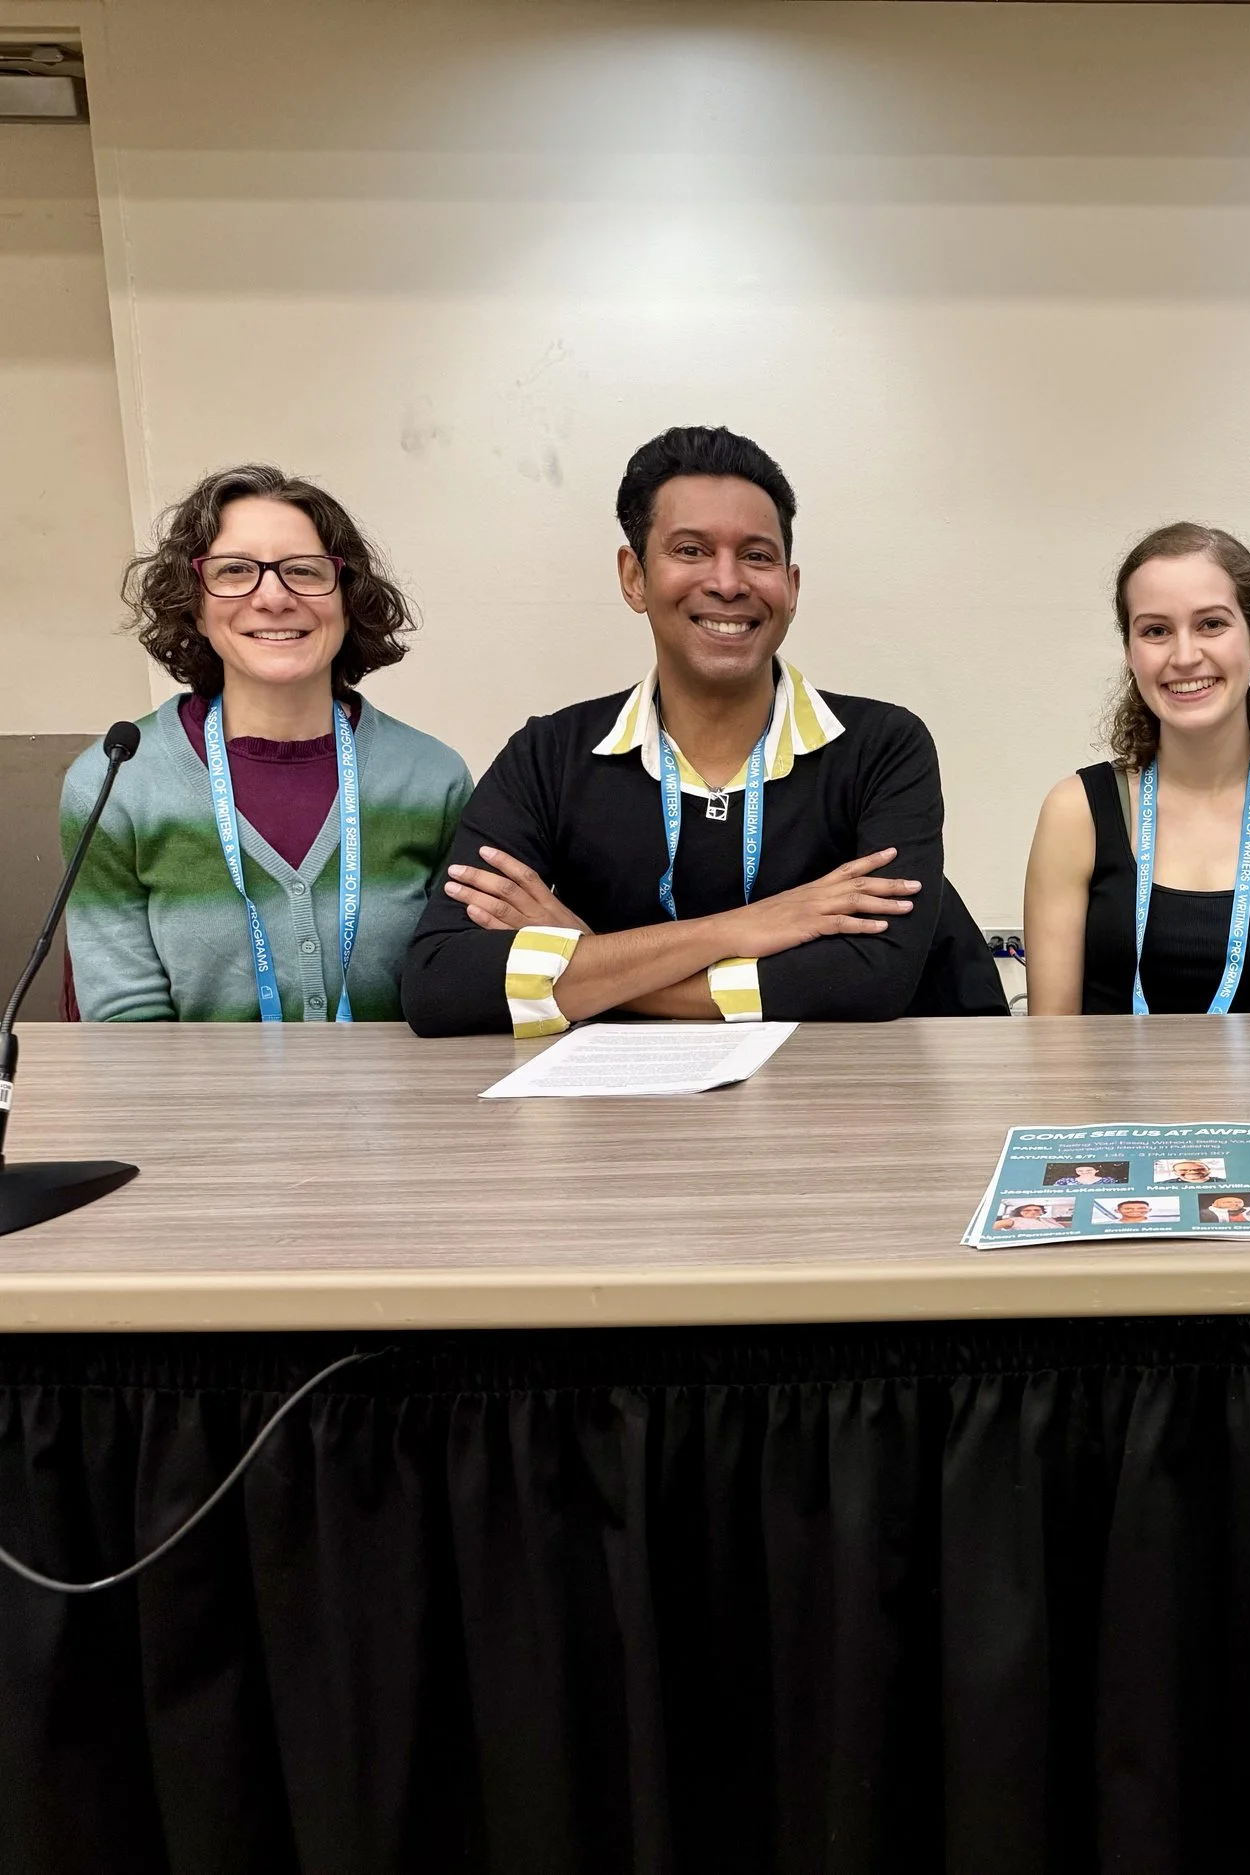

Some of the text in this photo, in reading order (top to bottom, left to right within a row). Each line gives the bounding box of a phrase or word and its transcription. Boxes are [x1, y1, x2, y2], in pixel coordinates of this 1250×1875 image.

[207, 705, 223, 777] ASSOCIATION
[665, 755, 676, 771] OF
[214, 780, 226, 795] OF
[666, 772, 679, 818] WRITERS
[748, 780, 759, 789] &
[1143, 766, 1154, 806] PROGR
[217, 798, 233, 842] WRITERS
[669, 820, 678, 828] &
[747, 791, 759, 834] WRITERS
[1141, 808, 1152, 851] WRITING
[225, 844, 234, 853] &
[338, 708, 357, 969] ASSOCIATION OF WRITERS & WRITING PROGRAMS
[746, 838, 757, 853] OF
[1139, 863, 1150, 905] WRITERS
[1239, 884, 1249, 892] &
[1138, 907, 1146, 920] OF
[1233, 894, 1249, 937] WRITING
[249, 904, 268, 972] PROGRAMS
[1220, 940, 1242, 998] PROGRAMS
[1019, 1132, 1087, 1141] COME
[1090, 1130, 1129, 1138] SEE
[1132, 1129, 1161, 1137] US
[1164, 1129, 1193, 1137] AT
